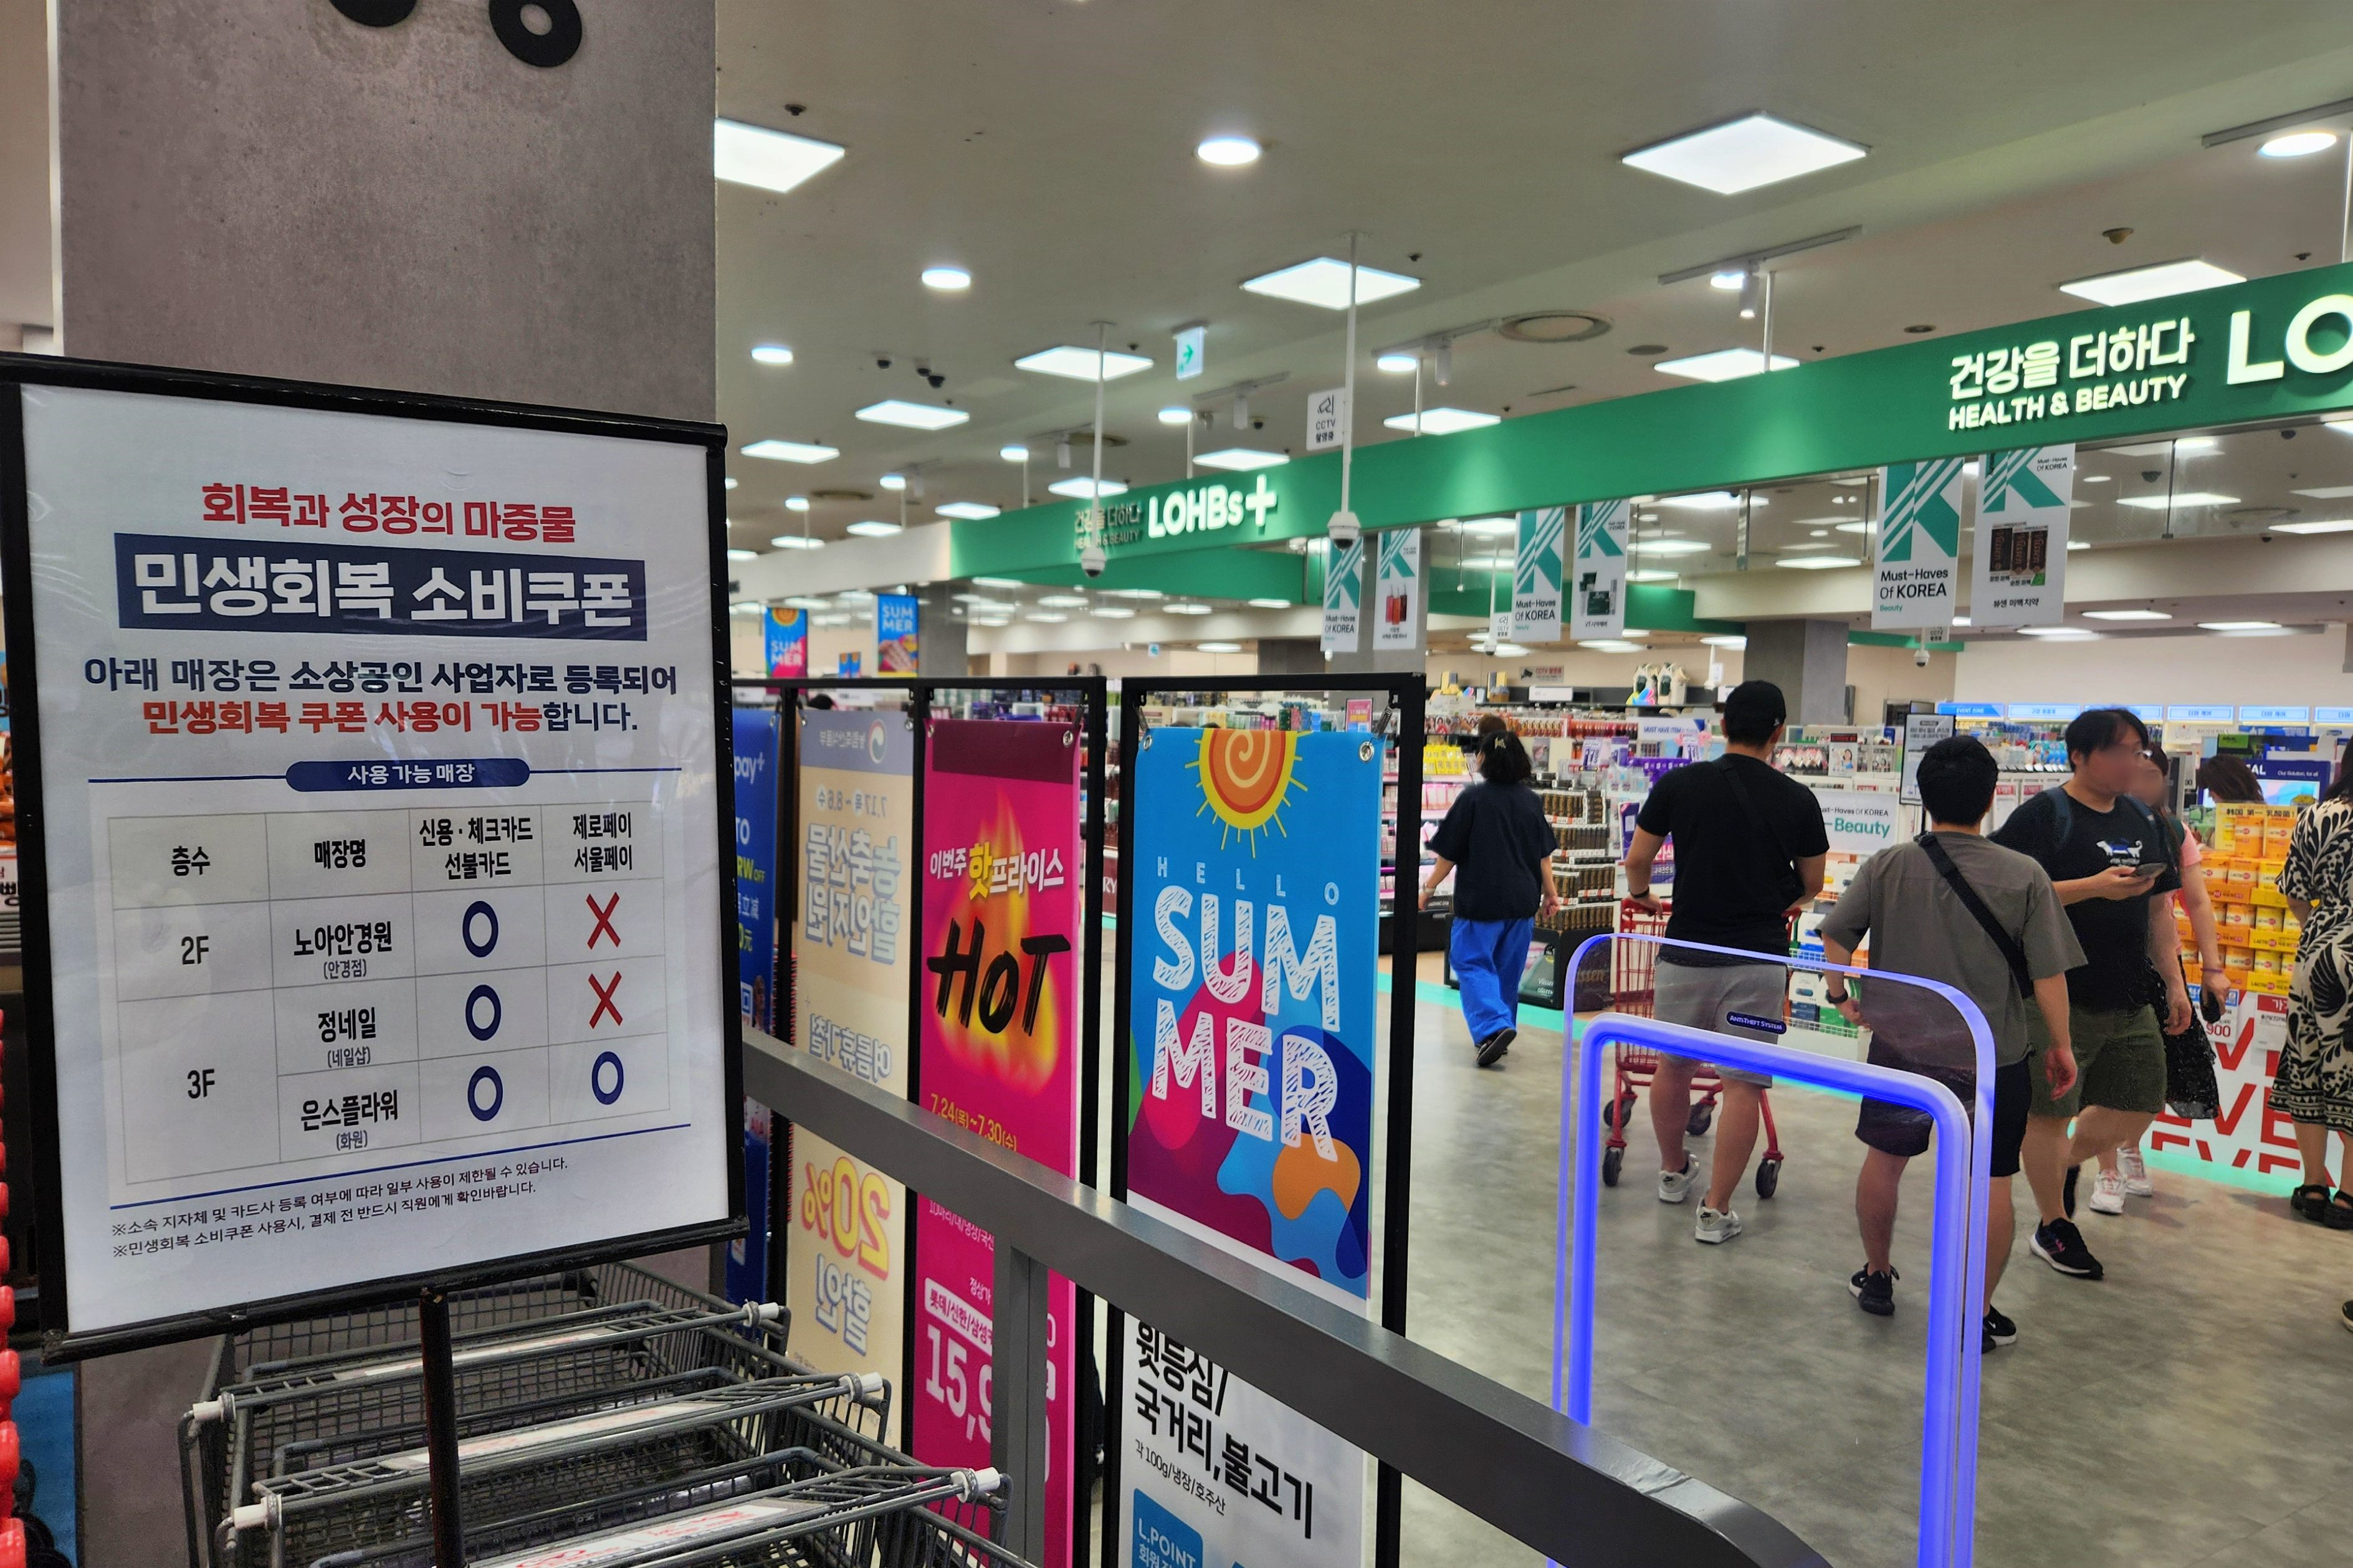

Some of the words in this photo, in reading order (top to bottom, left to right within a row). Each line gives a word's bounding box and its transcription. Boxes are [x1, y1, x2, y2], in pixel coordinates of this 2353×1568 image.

[1949, 341, 2060, 400] 건강을
[2069, 318, 2195, 379] 더하다
[1949, 394, 2043, 430] HEALTH
[2050, 391, 2069, 416] &
[2076, 374, 2187, 413] BEAUTY
[1316, 419, 1335, 430] CCTV
[201, 483, 330, 527] 회복과
[339, 493, 454, 535] 성장의
[464, 501, 576, 543] 마중물
[1881, 568, 1948, 581] Must-Haves
[135, 553, 392, 619] 민생회복
[411, 568, 632, 627] 소비쿠폰
[1515, 599, 1556, 608] Must-Haves
[1880, 586, 1894, 599] Of
[1896, 582, 1947, 598] KOREA
[2010, 599, 2023, 607] 미백
[2024, 598, 2039, 606] 치약
[882, 605, 913, 618] SUM
[882, 619, 913, 632] MER
[1515, 612, 1524, 621] Of
[1525, 610, 1555, 620] KOREA
[1325, 625, 1332, 633] Of
[1332, 624, 1354, 633] KOREA
[771, 640, 803, 653] SUM
[771, 653, 803, 665] MER
[85, 658, 158, 690] 아래
[173, 659, 279, 693] 매장은
[290, 662, 424, 693] 소상공인
[431, 663, 556, 695] 사업자로
[563, 665, 676, 696] 등록되어
[143, 701, 290, 734] 민생회복
[299, 701, 368, 734] 쿠폰
[374, 701, 472, 733] 사용이
[481, 701, 637, 733] 가능합니다.
[348, 765, 389, 785] 사용
[393, 764, 432, 784] 가능
[436, 763, 475, 783] 매장
[1820, 807, 1854, 815] ust-Haves
[573, 813, 631, 839] 제로페이
[1824, 817, 1891, 839] -Beauty
[171, 845, 211, 877] 층수
[314, 839, 366, 870] 매장명
[445, 852, 512, 880] 선불카드
[574, 845, 632, 872] 서울페이
[930, 847, 966, 880] 이번주
[1157, 856, 1340, 906] HELLO
[181, 936, 209, 965] 2F
[294, 922, 392, 957] 노아안경원
[324, 959, 366, 979] (안경점)
[1153, 885, 1340, 1032] SUM
[318, 1007, 376, 1043] 정네일
[327, 1047, 371, 1069] (네일샵)
[188, 1069, 215, 1098] 3F
[1152, 998, 1339, 1162] MER
[302, 1090, 399, 1131] 은스플라워
[336, 1129, 368, 1152] (화원)
[163, 1211, 208, 1228] 지자체
[212, 1208, 226, 1222] 및
[231, 1201, 274, 1218] 카드사
[278, 1196, 307, 1212] 등록
[311, 1188, 351, 1207] 여부에
[356, 1185, 383, 1199] 따라
[386, 1181, 413, 1195] 일부
[416, 1174, 455, 1190] 사용이
[459, 1167, 496, 1184] 제한될
[500, 1165, 512, 1177] 수
[516, 1157, 568, 1176] 있습니다.
[194, 1225, 254, 1245] 소비쿠폰
[257, 1217, 305, 1235] 사용시,
[309, 1211, 336, 1228] 결제
[340, 1209, 354, 1222] 전
[357, 1203, 397, 1219] 반드시
[401, 1194, 454, 1212] 직원에게
[457, 1181, 536, 1204] 확인바랍니다.
[930, 1288, 993, 1346] 롯데/신한/삼성
[1135, 1439, 1145, 1460] 각
[1138, 1518, 1196, 1567] L.POINT
